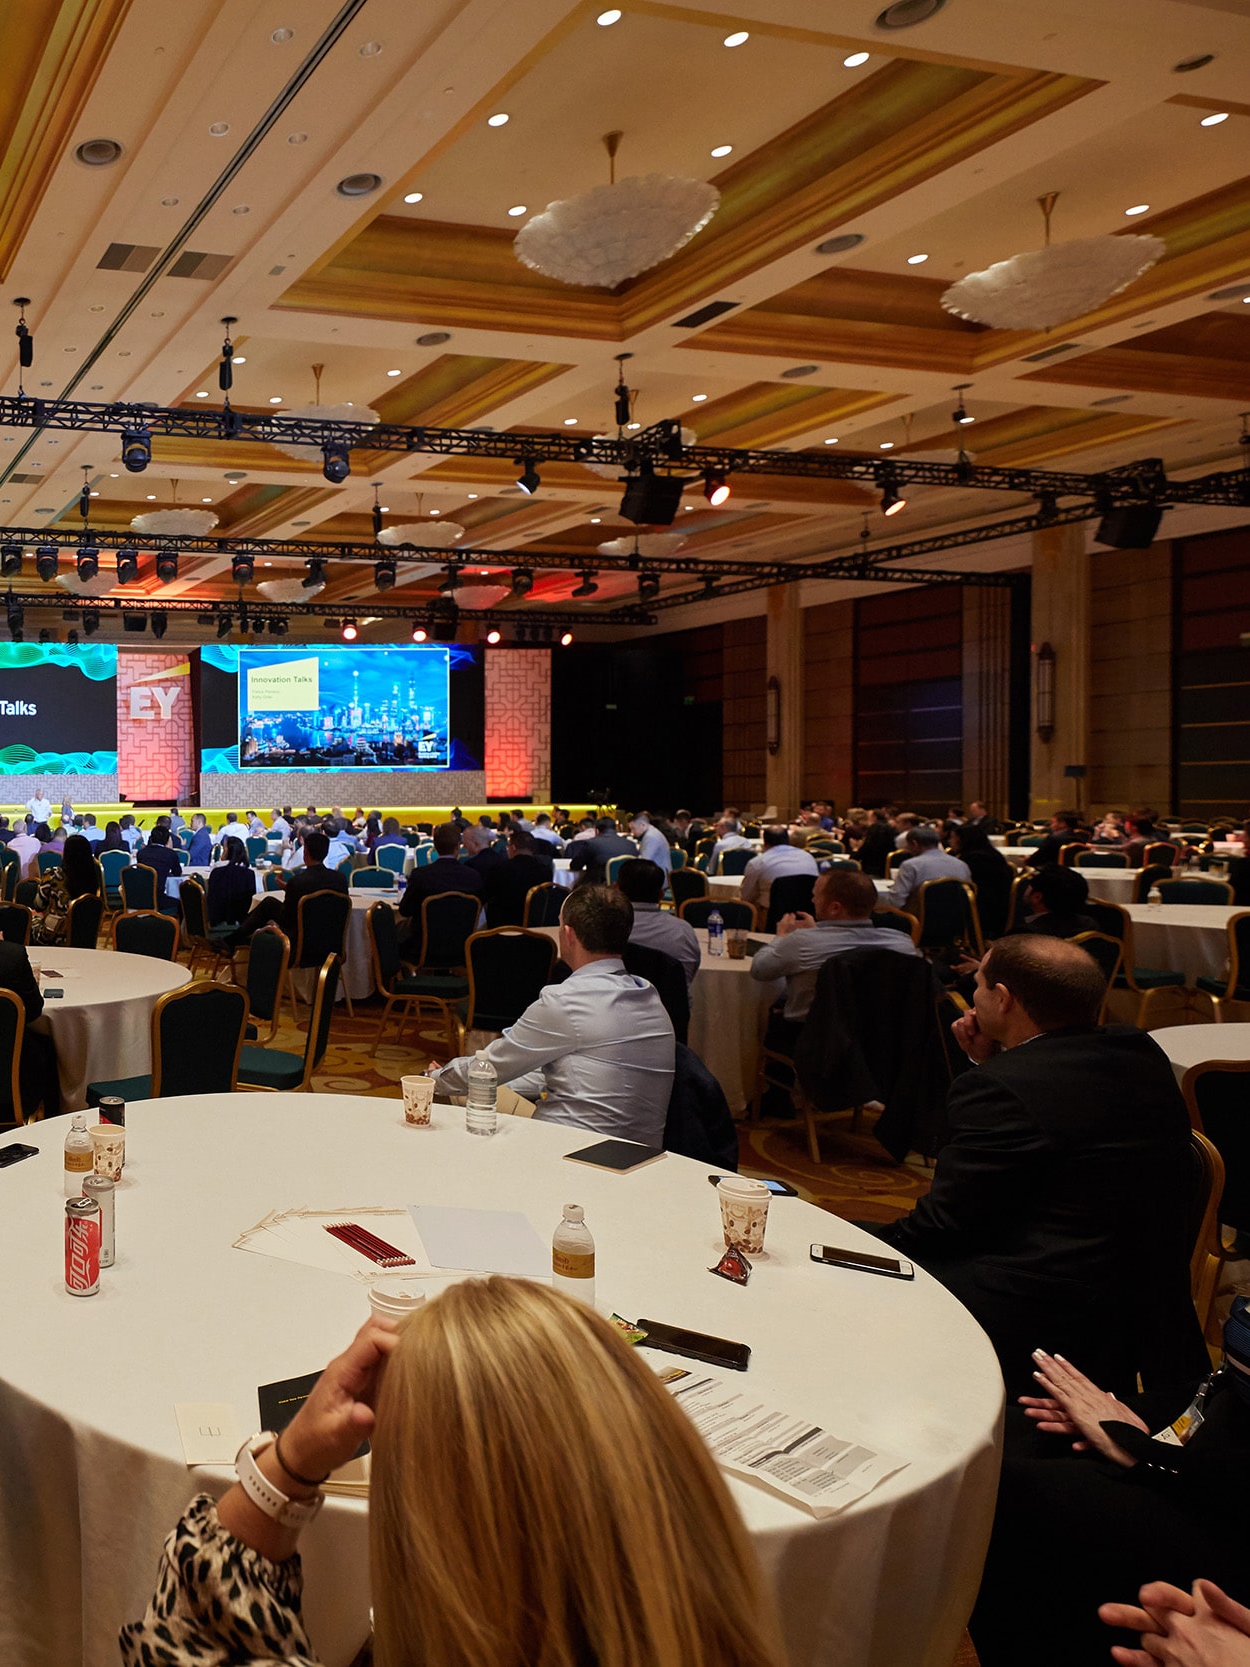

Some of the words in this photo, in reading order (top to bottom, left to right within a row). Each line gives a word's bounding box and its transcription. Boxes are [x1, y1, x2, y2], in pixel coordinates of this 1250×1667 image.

[251, 676, 291, 684] Innovation
[293, 675, 313, 683] Talks
[130, 686, 182, 720] EY
[417, 740, 434, 752] EY
[68, 1217, 89, 1291] 可口可乐
